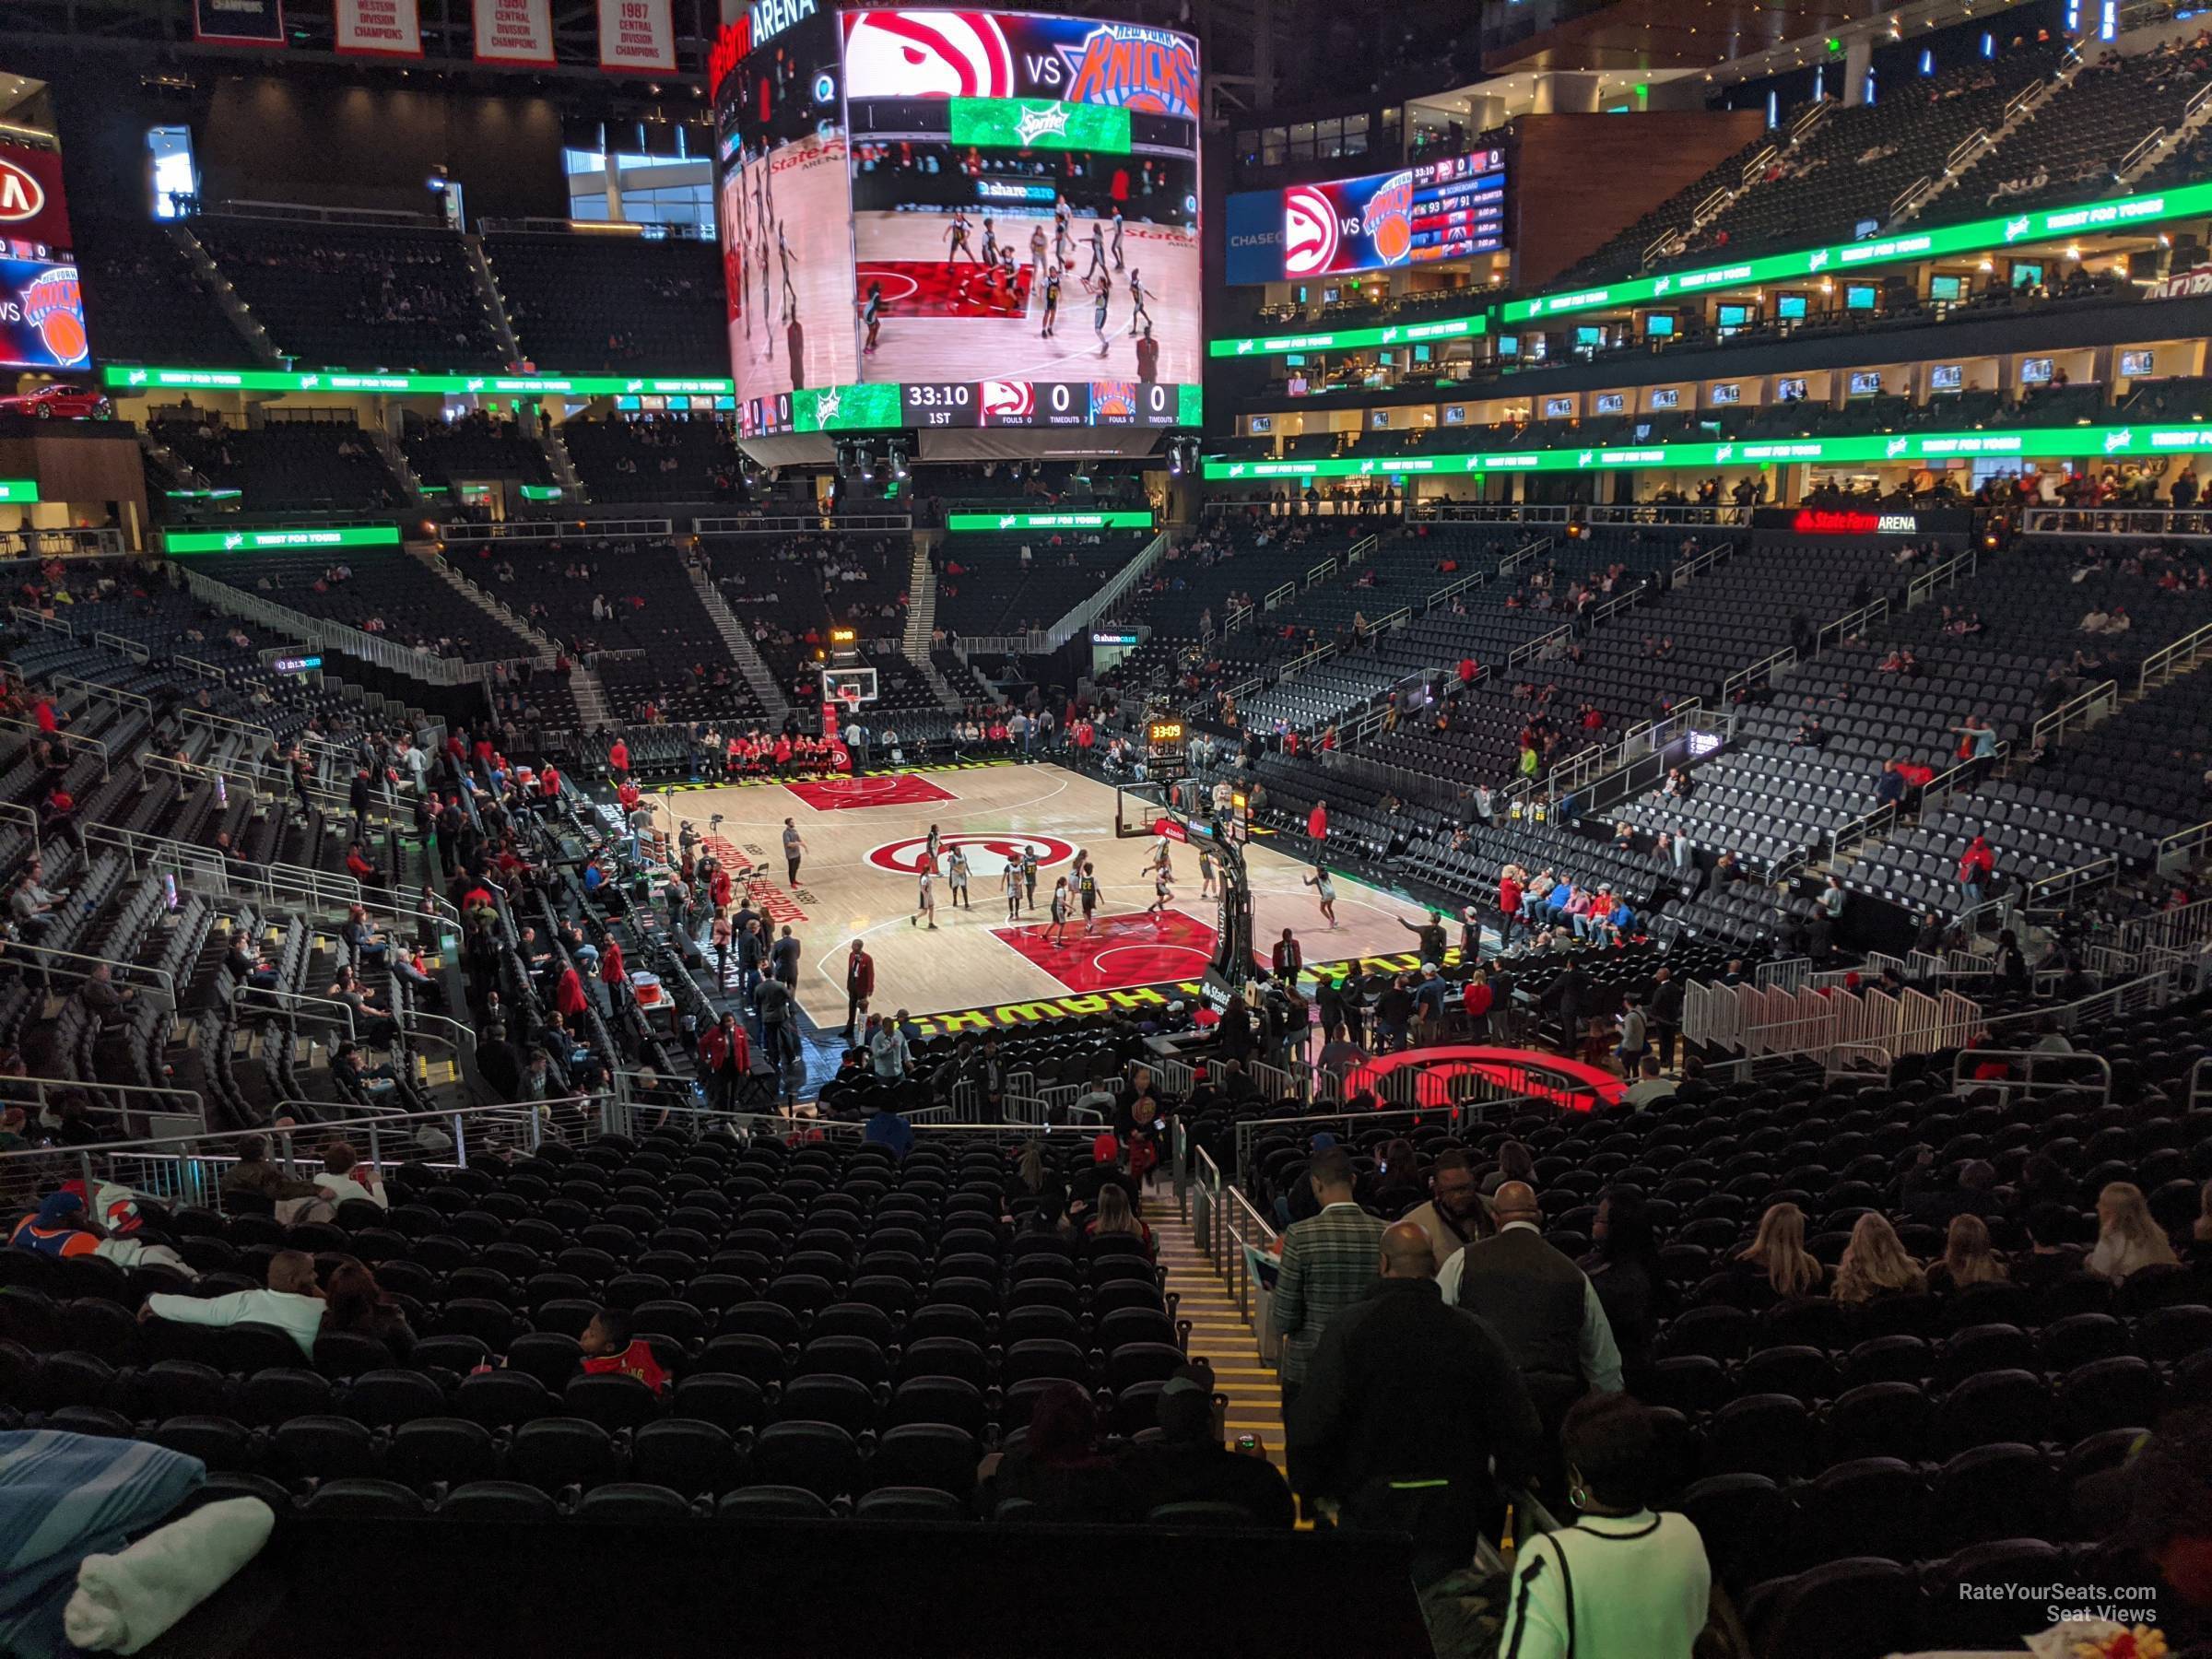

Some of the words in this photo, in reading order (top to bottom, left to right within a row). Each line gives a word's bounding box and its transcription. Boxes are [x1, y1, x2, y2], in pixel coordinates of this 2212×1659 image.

[495, 10, 531, 23] CENTRAL
[621, 3, 649, 19] 1987
[359, 14, 395, 26] DIVISION
[619, 20, 653, 32] CENTRAL
[354, 27, 404, 41] CHAMPIONS
[497, 24, 531, 36] DIVISION
[1116, 26, 1142, 40] NEW
[1144, 29, 1173, 47] YORK
[491, 37, 537, 50] CHAMPIONS
[620, 33, 653, 45] DIVISION
[616, 45, 660, 59] CHAMPIONS
[1027, 55, 1061, 84] VS
[1071, 36, 1198, 116] KNICKS
[1022, 113, 1064, 134] Sprite
[1491, 150, 1499, 164] 0
[1416, 166, 1435, 177] 33:10
[1458, 158, 1465, 171] 0
[990, 182, 1055, 199] sharecare
[1447, 182, 1478, 194] SCOREBOARD
[1430, 201, 1440, 212] 93
[1461, 195, 1470, 206] 91
[2047, 212, 2088, 229] THIRST
[2119, 199, 2163, 218] YOURS
[1341, 218, 1359, 235] VS
[909, 385, 969, 406] 33:10
[1052, 384, 1070, 412] 0
[1150, 385, 1165, 412] 0
[780, 394, 787, 420] 0
[929, 413, 951, 424] 1ST
[1029, 517, 1056, 525] THIRST
[1076, 516, 1101, 524] YOURS
[1815, 511, 1878, 528] StateFarm
[1877, 516, 1915, 530] ARENA
[256, 535, 286, 545] THIRST
[309, 533, 341, 543] YOURS
[1100, 634, 1135, 643] sharecare
[1153, 724, 1181, 738] 33:09
[1217, 900, 1227, 948] xfinity
